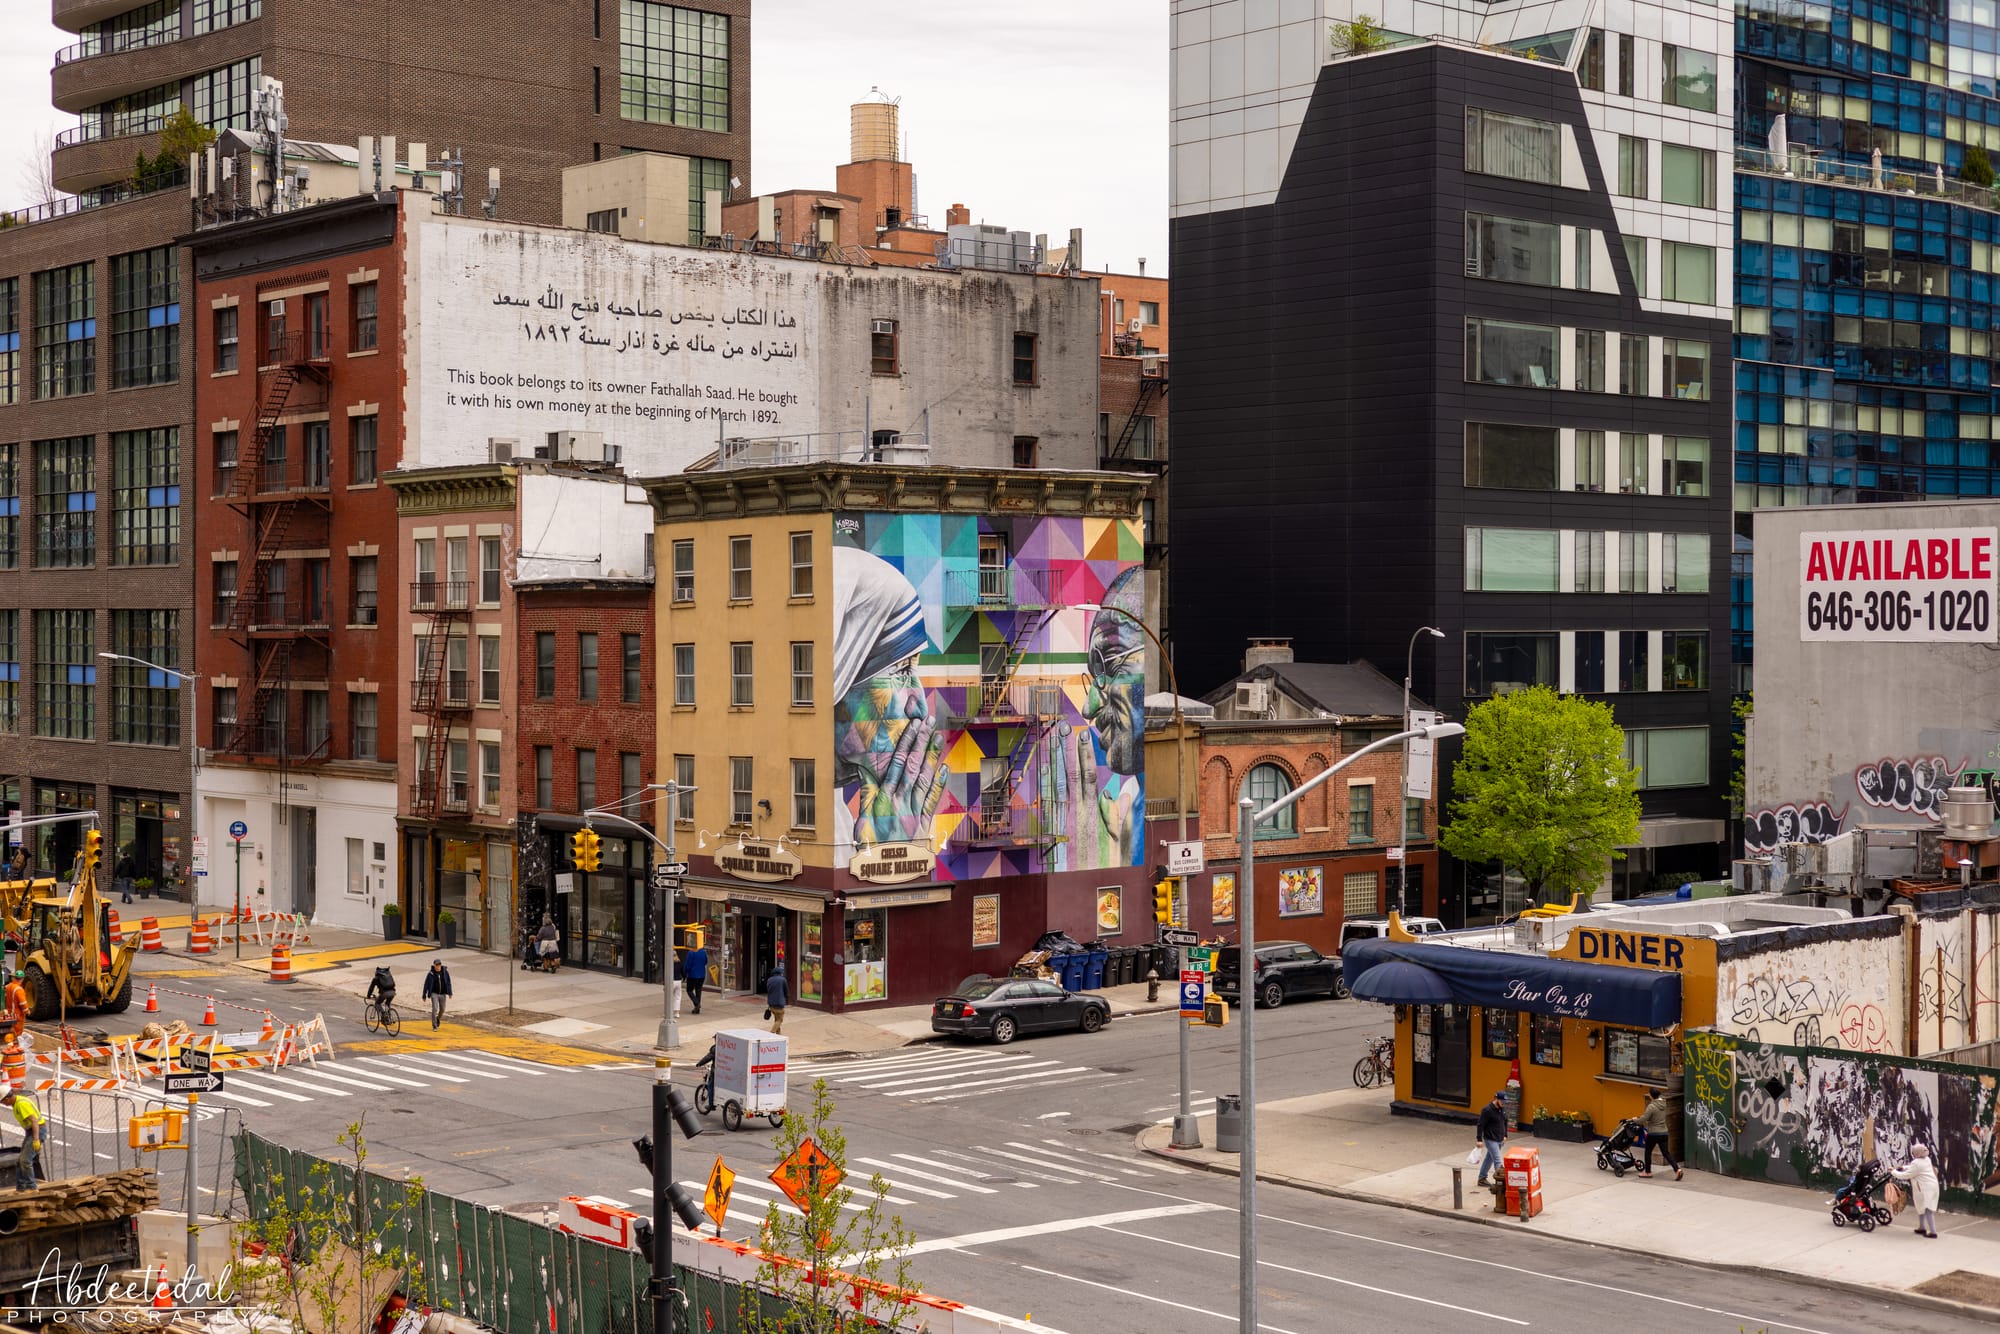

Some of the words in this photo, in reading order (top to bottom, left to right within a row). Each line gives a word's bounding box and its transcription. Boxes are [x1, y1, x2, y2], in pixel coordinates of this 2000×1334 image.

[493, 292, 530, 307] سعد
[571, 295, 600, 320] فتح
[607, 298, 663, 320] صاحبه
[670, 305, 714, 327] يخص
[722, 306, 767, 330] الكتاب
[773, 309, 796, 328] هذا
[524, 321, 570, 344] ١٨٩٢
[578, 325, 611, 346] سنة
[615, 330, 645, 353] اذار
[652, 332, 680, 355] غرة
[722, 340, 744, 359] من
[751, 340, 797, 362] اشتراه
[447, 369, 475, 384] This
[480, 371, 513, 386] book
[518, 374, 566, 393] belongs
[570, 380, 584, 391] to
[588, 379, 602, 391] its
[607, 384, 646, 395] owner
[651, 382, 702, 398] Fathallah
[706, 386, 735, 400] Saad.
[738, 388, 755, 401] He
[759, 390, 798, 407] bought
[447, 392, 456, 405] it
[461, 393, 489, 407] with
[494, 394, 512, 409] his
[517, 400, 544, 410] own
[549, 402, 591, 416] money
[595, 403, 607, 414] at
[611, 402, 632, 415] the
[635, 403, 691, 422] beginning
[695, 407, 708, 419] of
[711, 407, 747, 422] March
[752, 410, 781, 424] 1892.
[1806, 537, 1991, 581] AVAILABLE
[1808, 590, 1990, 631] 646-306-1020
[743, 846, 770, 858] CHELSEA
[881, 847, 907, 859] CHELSEA
[722, 857, 754, 871] SQUARE
[756, 860, 793, 875] MARKET
[860, 862, 892, 878] SQUARE
[894, 859, 928, 874] MARKET
[1183, 935, 1195, 943] WAY
[1579, 931, 1684, 969] DINER
[1191, 947, 1198, 957] 10
[1503, 979, 1541, 1001] Star
[1545, 985, 1568, 1005] On
[1573, 992, 1593, 1007] 18
[1553, 1005, 1572, 1015] Diner
[173, 1079, 191, 1088] ONE
[198, 1078, 216, 1088] WAY
